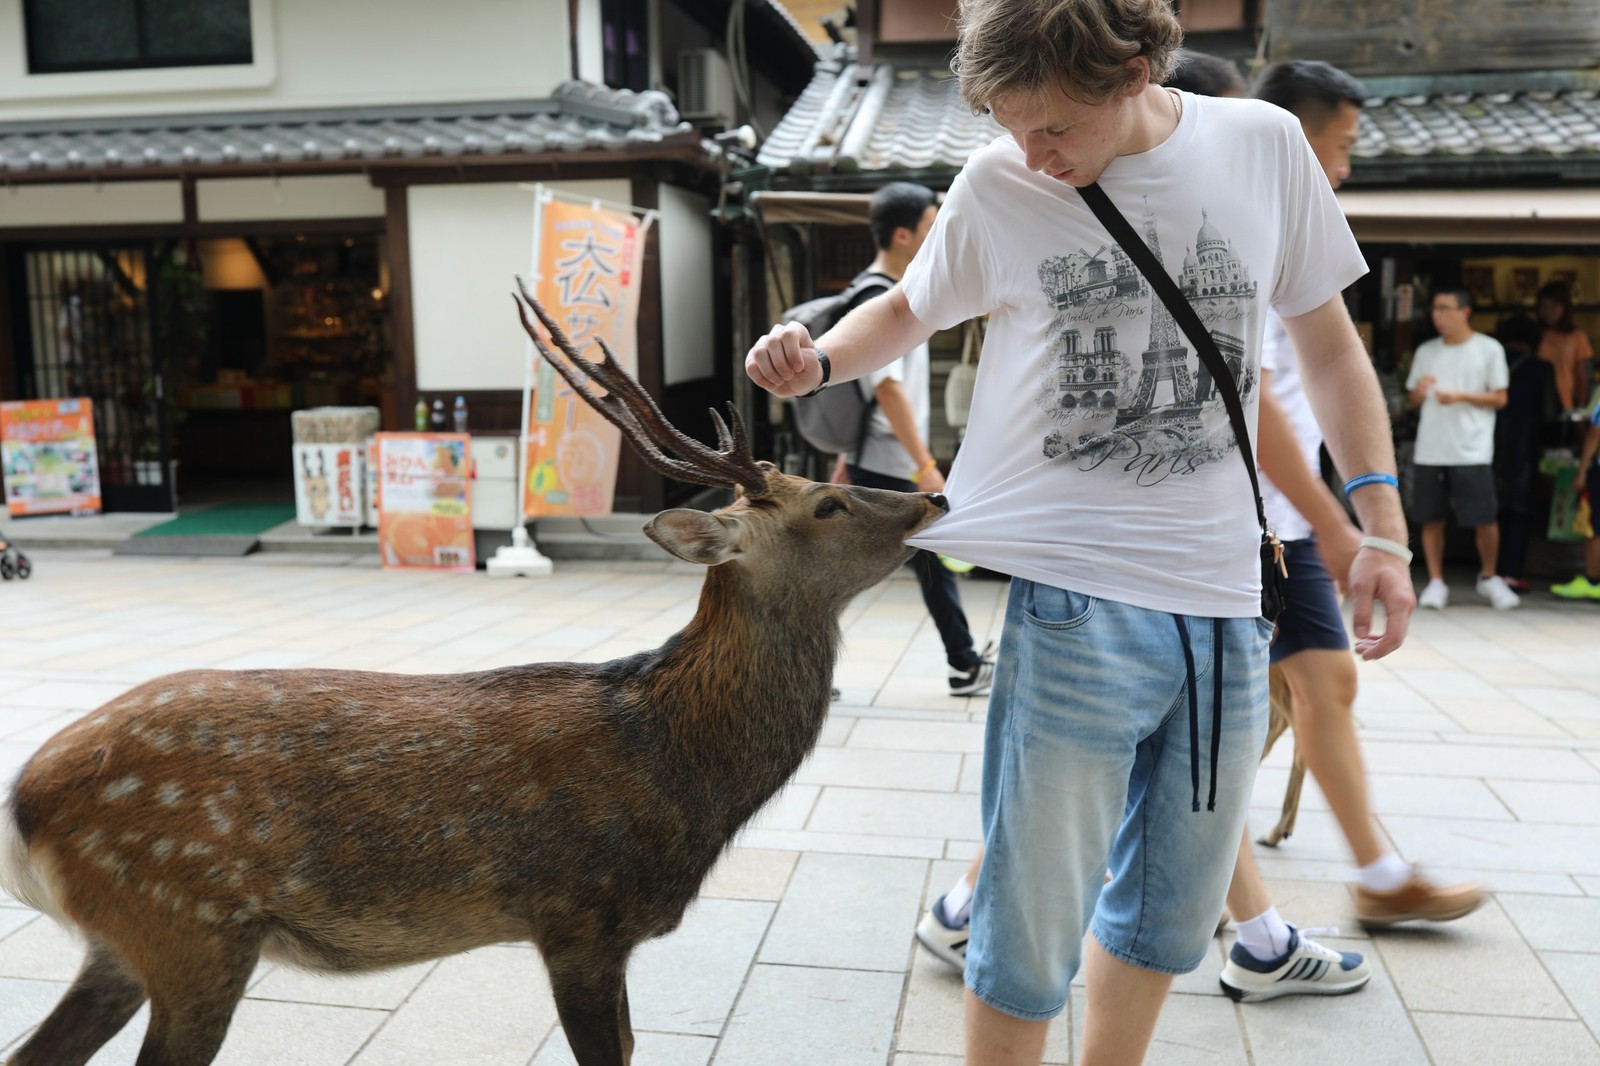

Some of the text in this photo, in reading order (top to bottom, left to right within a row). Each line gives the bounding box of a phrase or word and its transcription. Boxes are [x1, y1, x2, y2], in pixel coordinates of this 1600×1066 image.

[1055, 299, 1147, 323] Moulin de Paris
[1078, 431, 1212, 487] Paris
